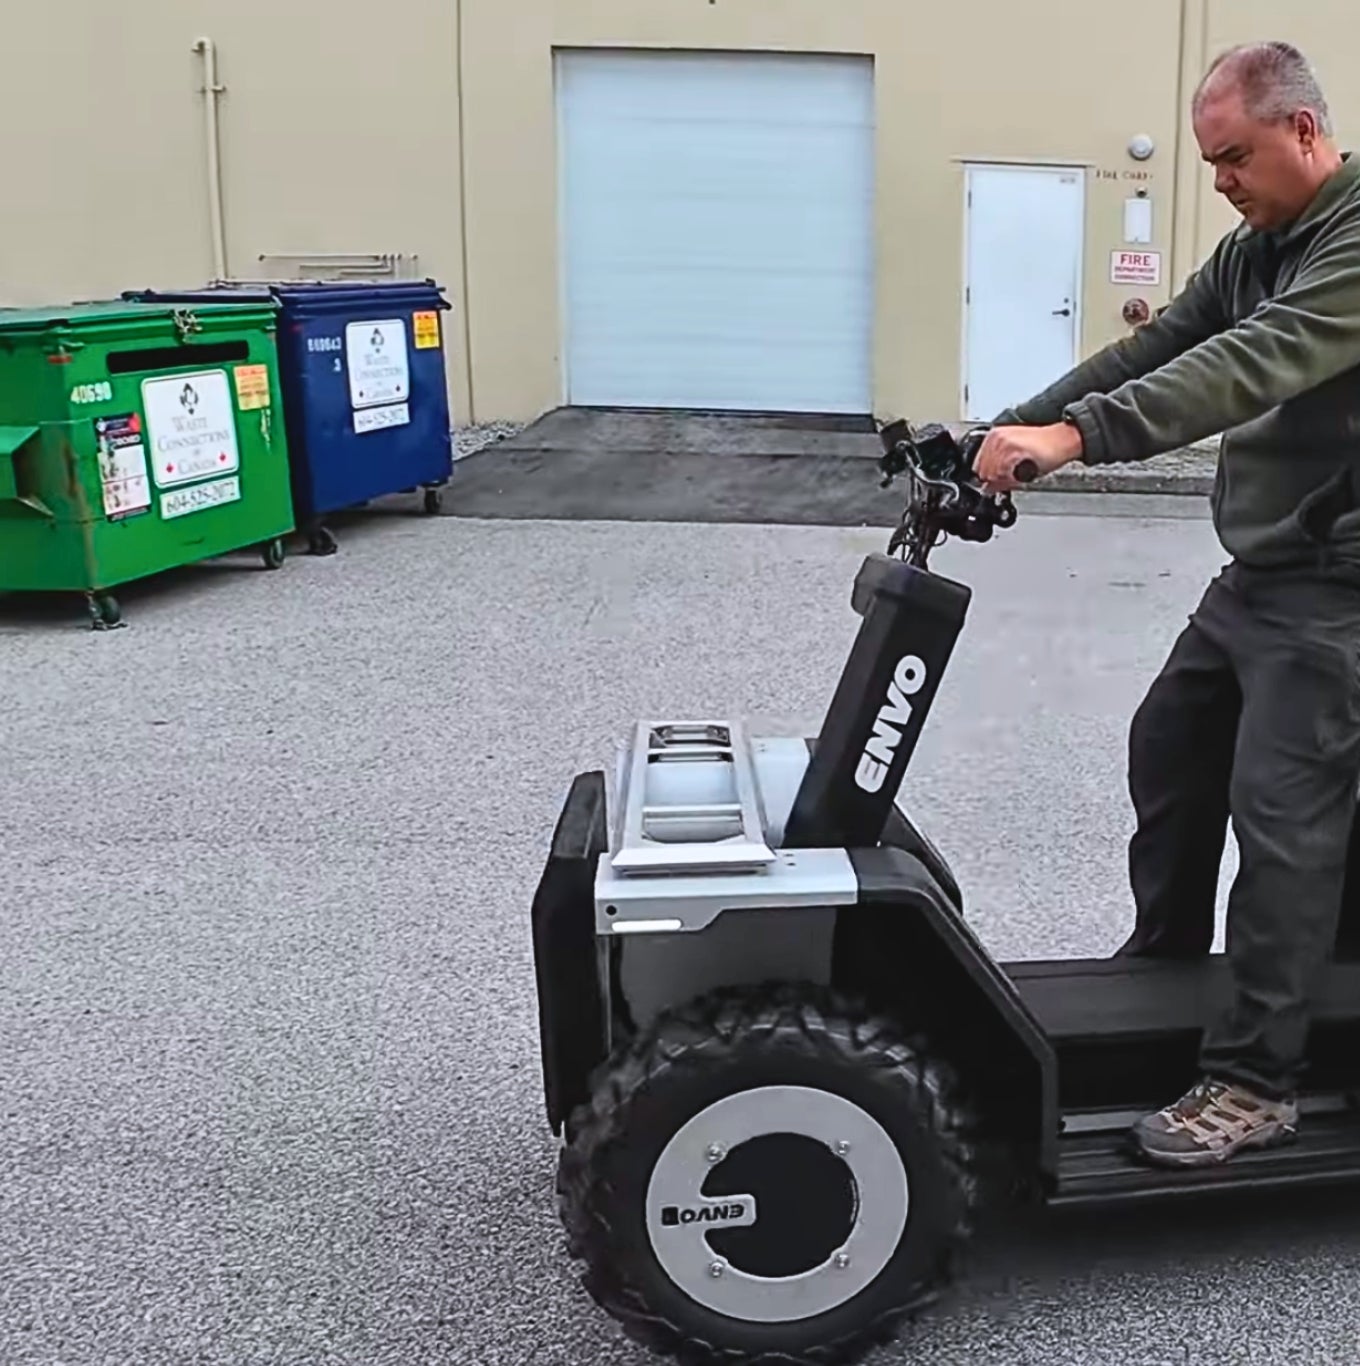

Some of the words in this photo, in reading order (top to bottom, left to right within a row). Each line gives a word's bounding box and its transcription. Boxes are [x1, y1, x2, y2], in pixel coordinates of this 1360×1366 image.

[1120, 253, 1151, 266] FIRE
[854, 655, 926, 793] ENVO
[680, 1204, 744, 1223] ENVO
